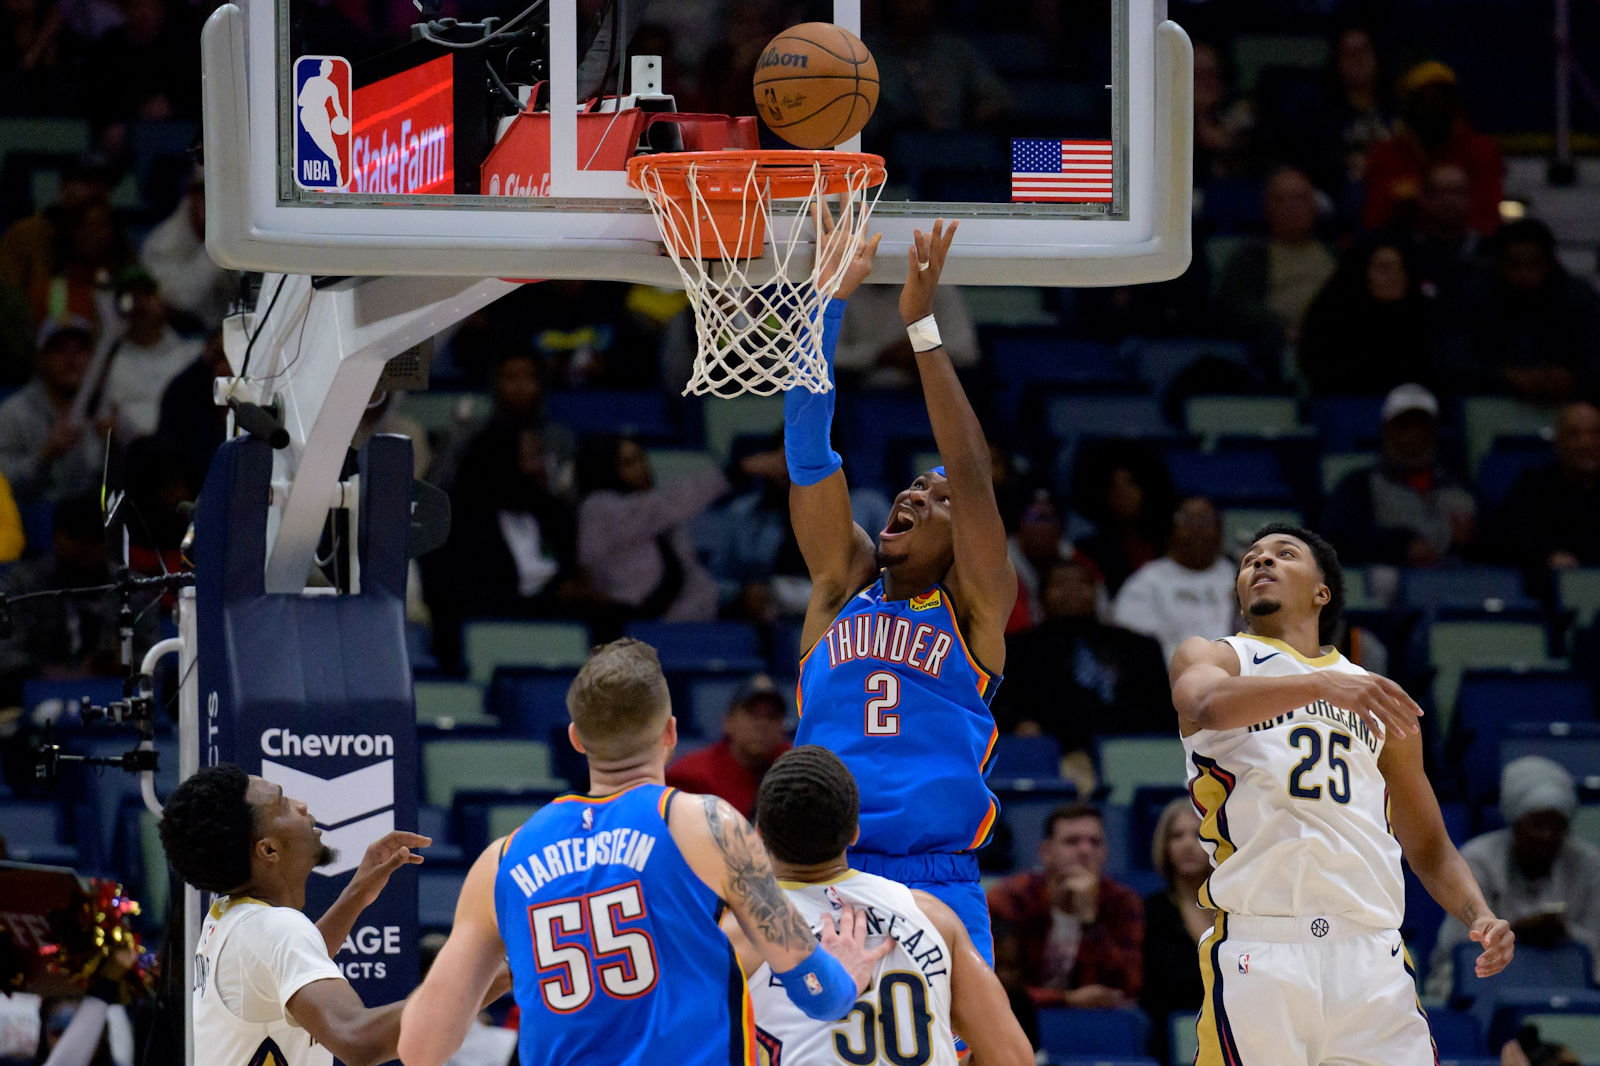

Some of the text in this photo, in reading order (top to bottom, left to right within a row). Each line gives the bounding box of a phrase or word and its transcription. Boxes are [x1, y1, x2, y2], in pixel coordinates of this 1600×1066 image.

[303, 159, 331, 181] NBA
[826, 612, 953, 678] THUNDER
[865, 671, 900, 736] 2
[261, 728, 394, 757] Chevron
[1288, 725, 1352, 806] 25
[510, 828, 656, 898] HARTENSTEIN
[336, 926, 401, 955] AGE
[528, 880, 660, 1014] 55
